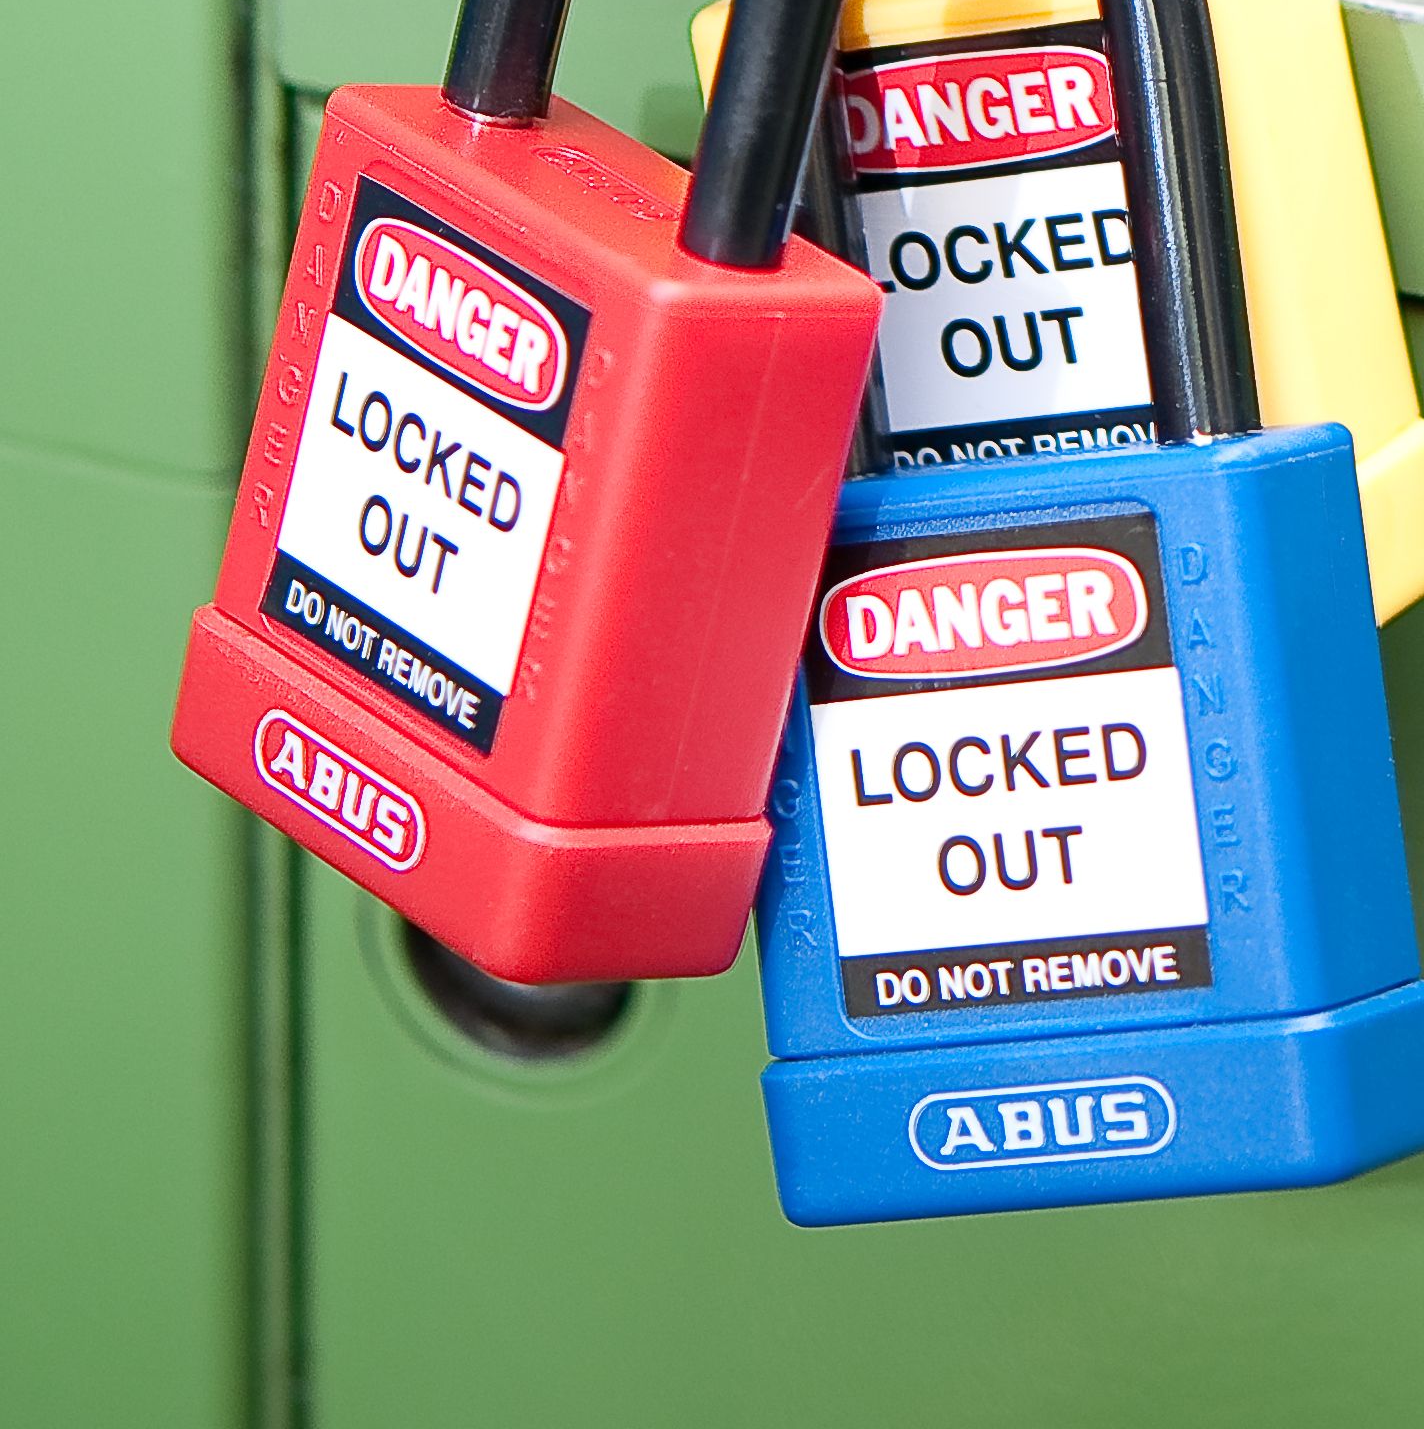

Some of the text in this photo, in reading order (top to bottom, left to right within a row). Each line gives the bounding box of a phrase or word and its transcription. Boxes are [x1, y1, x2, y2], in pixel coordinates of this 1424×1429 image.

[846, 65, 1101, 154] DANGER
[880, 208, 1134, 293] OCKED
[369, 233, 550, 395] DANGER
[941, 306, 1084, 377] OUT
[330, 371, 522, 533] LOCKED
[1032, 421, 1158, 454] REMOV
[358, 494, 460, 595] OUT
[285, 579, 482, 730] DO NOT REMOVE
[846, 569, 1119, 660] DANGER
[850, 722, 1148, 807] LOCKED
[1177, 541, 1250, 914] DANGER
[269, 729, 411, 855] ABUS
[938, 825, 1083, 896] OUT
[875, 945, 1181, 1006] DO NOT REMOVE
[940, 1091, 1149, 1156] ABUS
